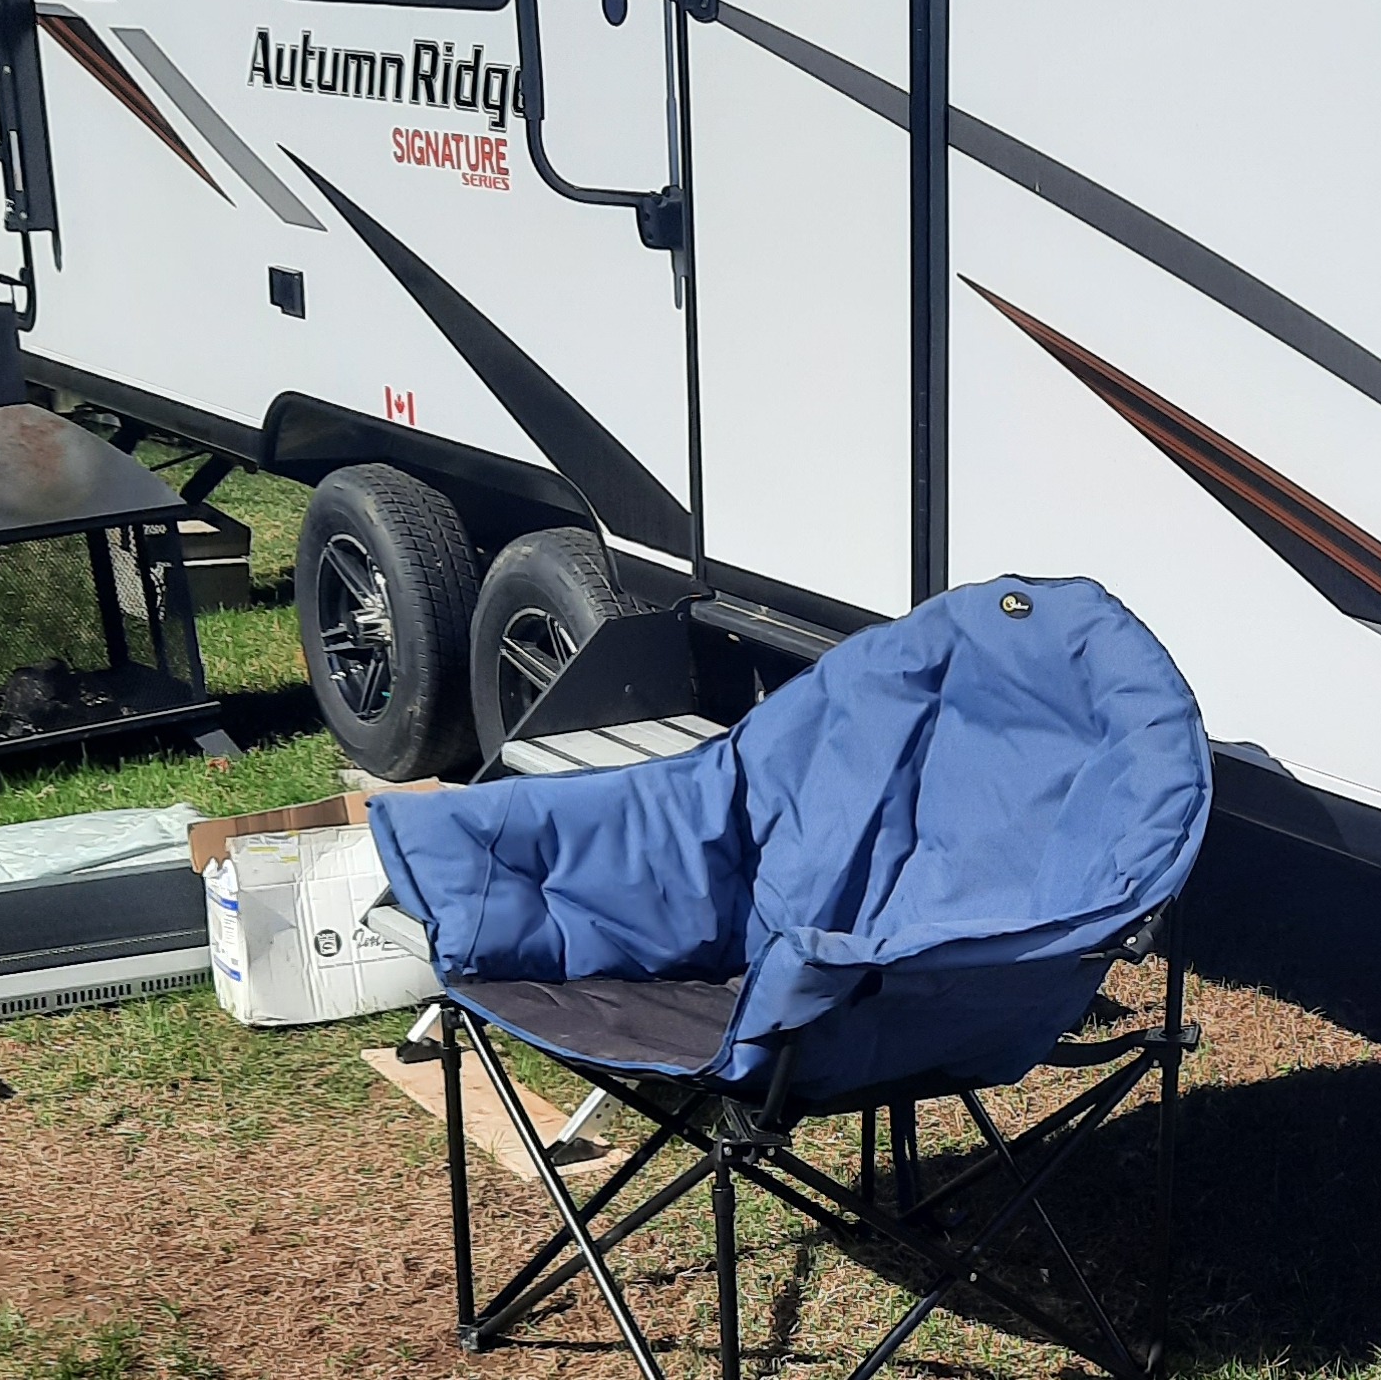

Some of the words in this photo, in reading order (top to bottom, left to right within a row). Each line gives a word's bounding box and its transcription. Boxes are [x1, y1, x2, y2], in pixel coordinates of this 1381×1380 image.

[247, 27, 405, 104] Autumn
[392, 127, 510, 176] SIGNATURE
[461, 172, 510, 191] SERIES
